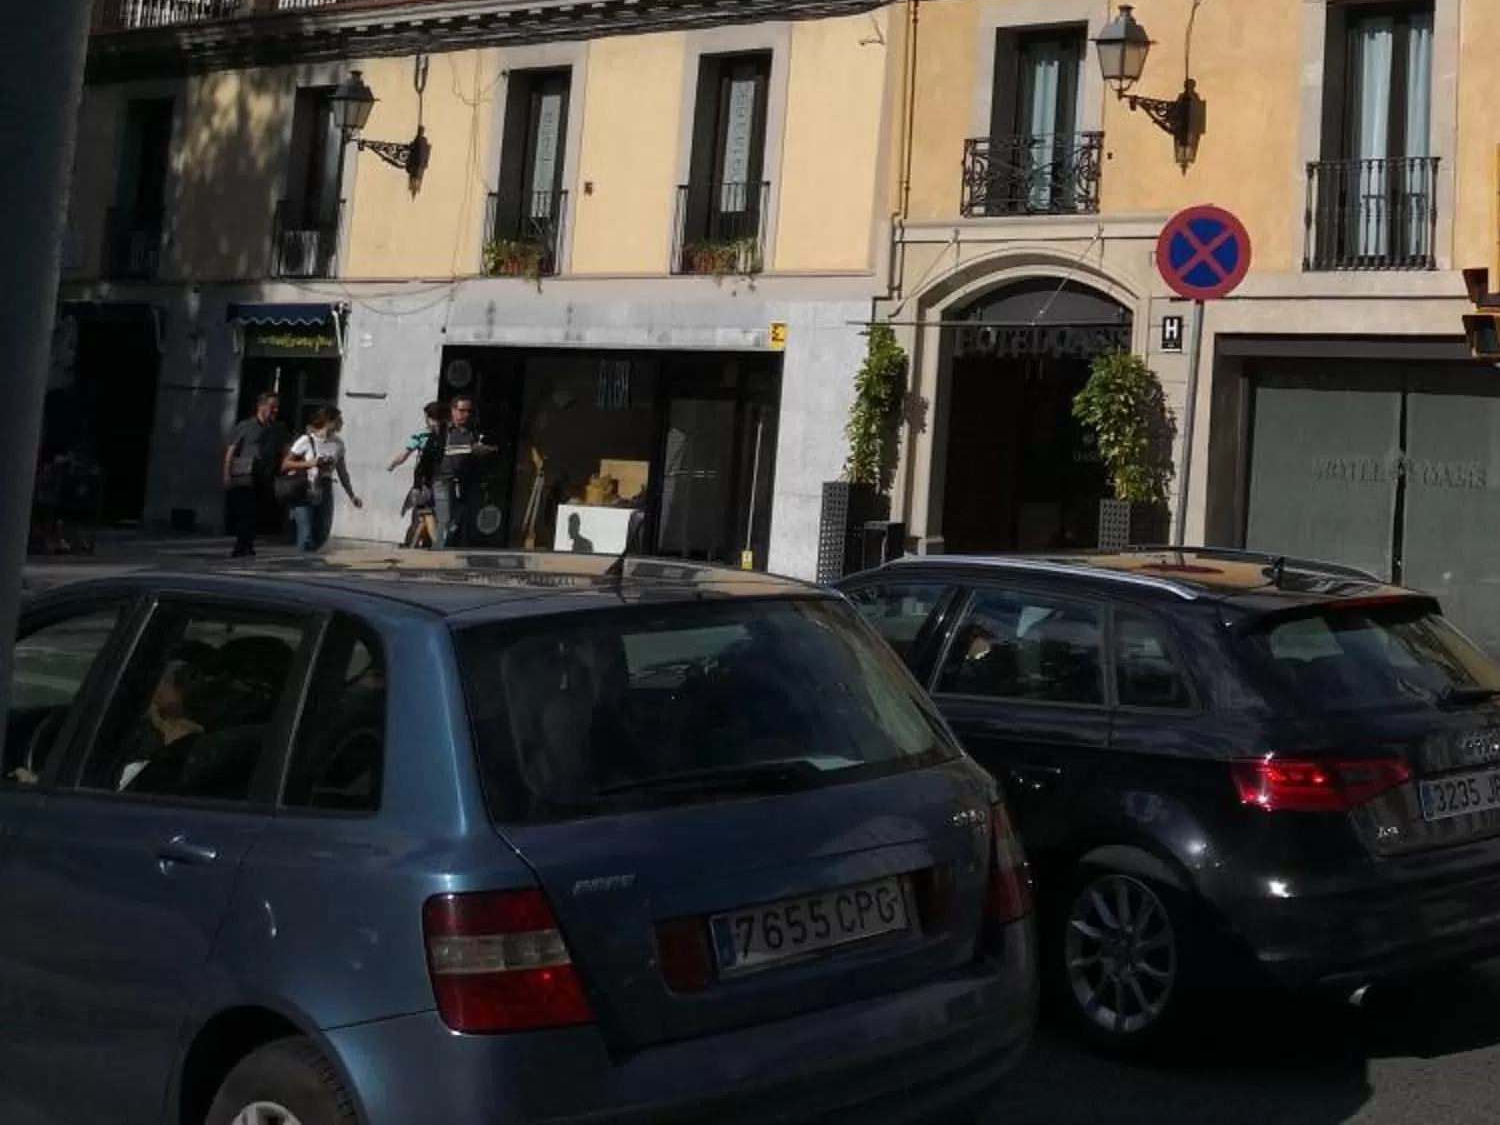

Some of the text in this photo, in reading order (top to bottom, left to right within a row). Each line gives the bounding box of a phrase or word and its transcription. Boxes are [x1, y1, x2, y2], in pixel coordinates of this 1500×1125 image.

[1165, 318, 1179, 340] H
[1437, 778, 1481, 811] 3235
[736, 886, 900, 959] 7655 CPG
